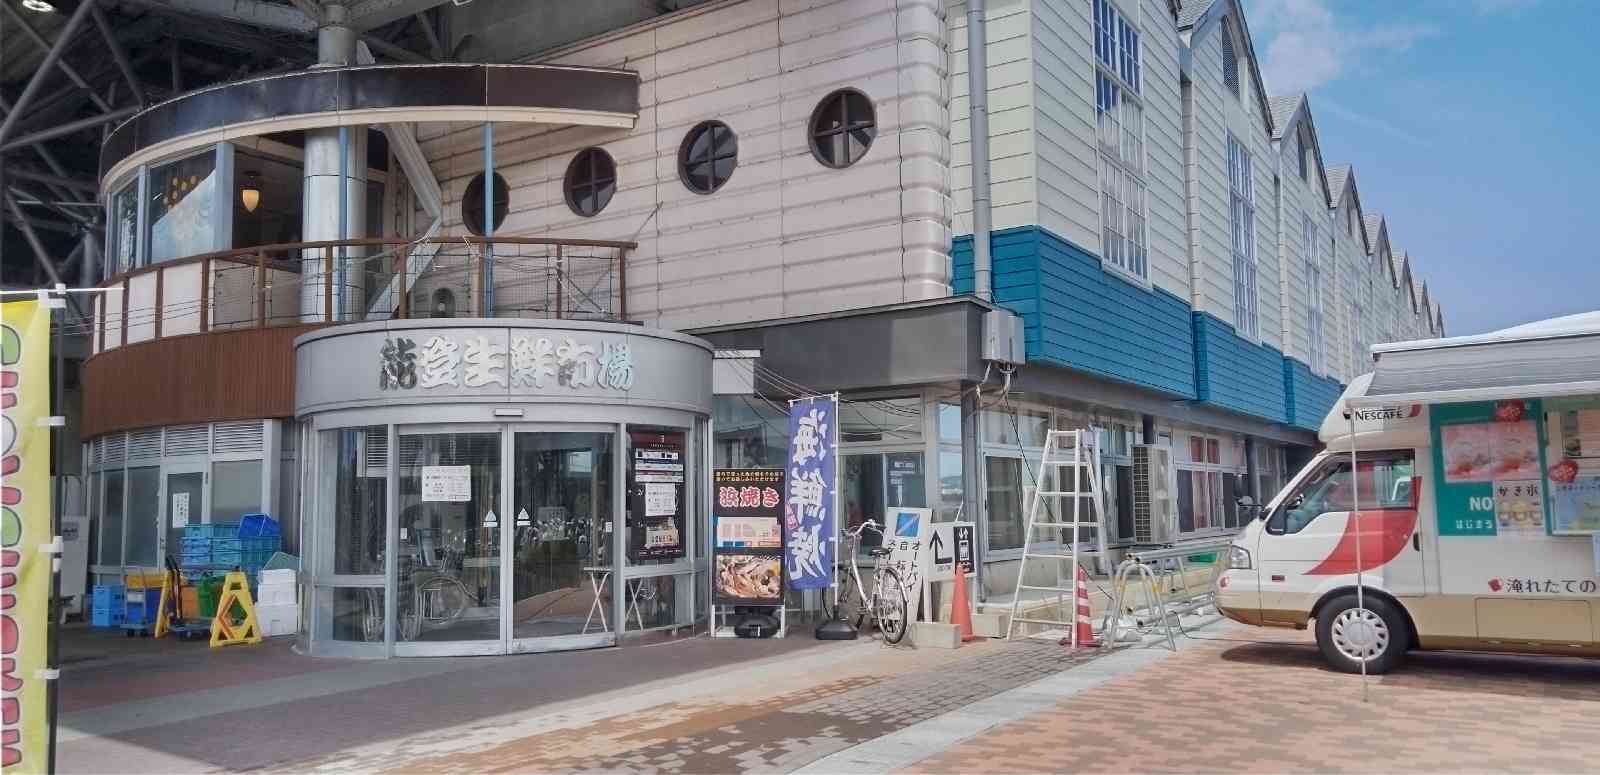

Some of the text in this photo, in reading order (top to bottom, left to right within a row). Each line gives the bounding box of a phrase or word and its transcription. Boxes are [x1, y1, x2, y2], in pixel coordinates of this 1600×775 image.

[380, 335, 632, 391] 能登生鮮市場
[719, 486, 780, 508] 浜焼き
[1505, 579, 1596, 593] 淹れたての
